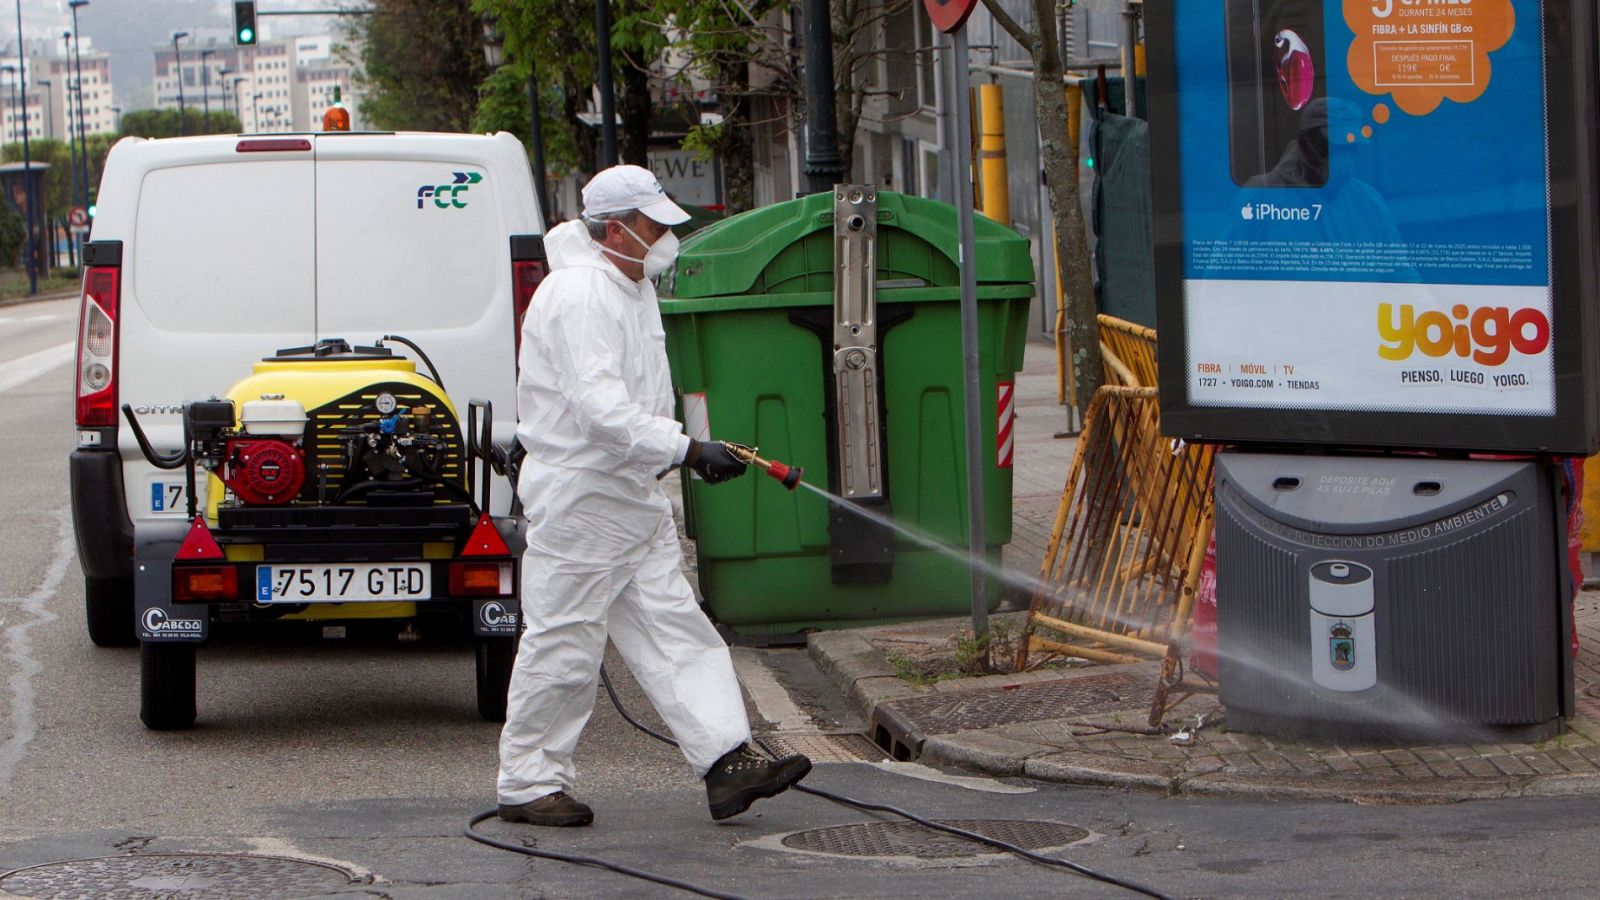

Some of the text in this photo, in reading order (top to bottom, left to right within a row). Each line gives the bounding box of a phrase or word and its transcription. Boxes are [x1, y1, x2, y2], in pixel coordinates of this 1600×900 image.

[1399, 8, 1472, 17] DURANTE 24 MESES
[1372, 24, 1397, 34] FIBRA
[1407, 24, 1418, 34] LA
[1420, 54, 1438, 62] PAGO
[418, 185, 468, 209] FCC
[1256, 203, 1322, 220] iPhone 7
[1377, 302, 1550, 367] yoigo
[1197, 362, 1295, 375] FIBRA MÓVIL TV
[1199, 378, 1320, 390] 1727 YOIGO.COM TIENDAS
[1401, 369, 1529, 387] PIENSO, LUEGO YOIGO.
[134, 405, 184, 415] CITR
[1320, 475, 1370, 486] DEPOSITE
[1366, 536, 1384, 548] DO
[1389, 527, 1431, 545] MEDIO
[1434, 499, 1501, 534] AMBIENTE
[279, 569, 355, 596] 7517
[367, 568, 424, 595] GTD
[485, 603, 516, 625] CAB
